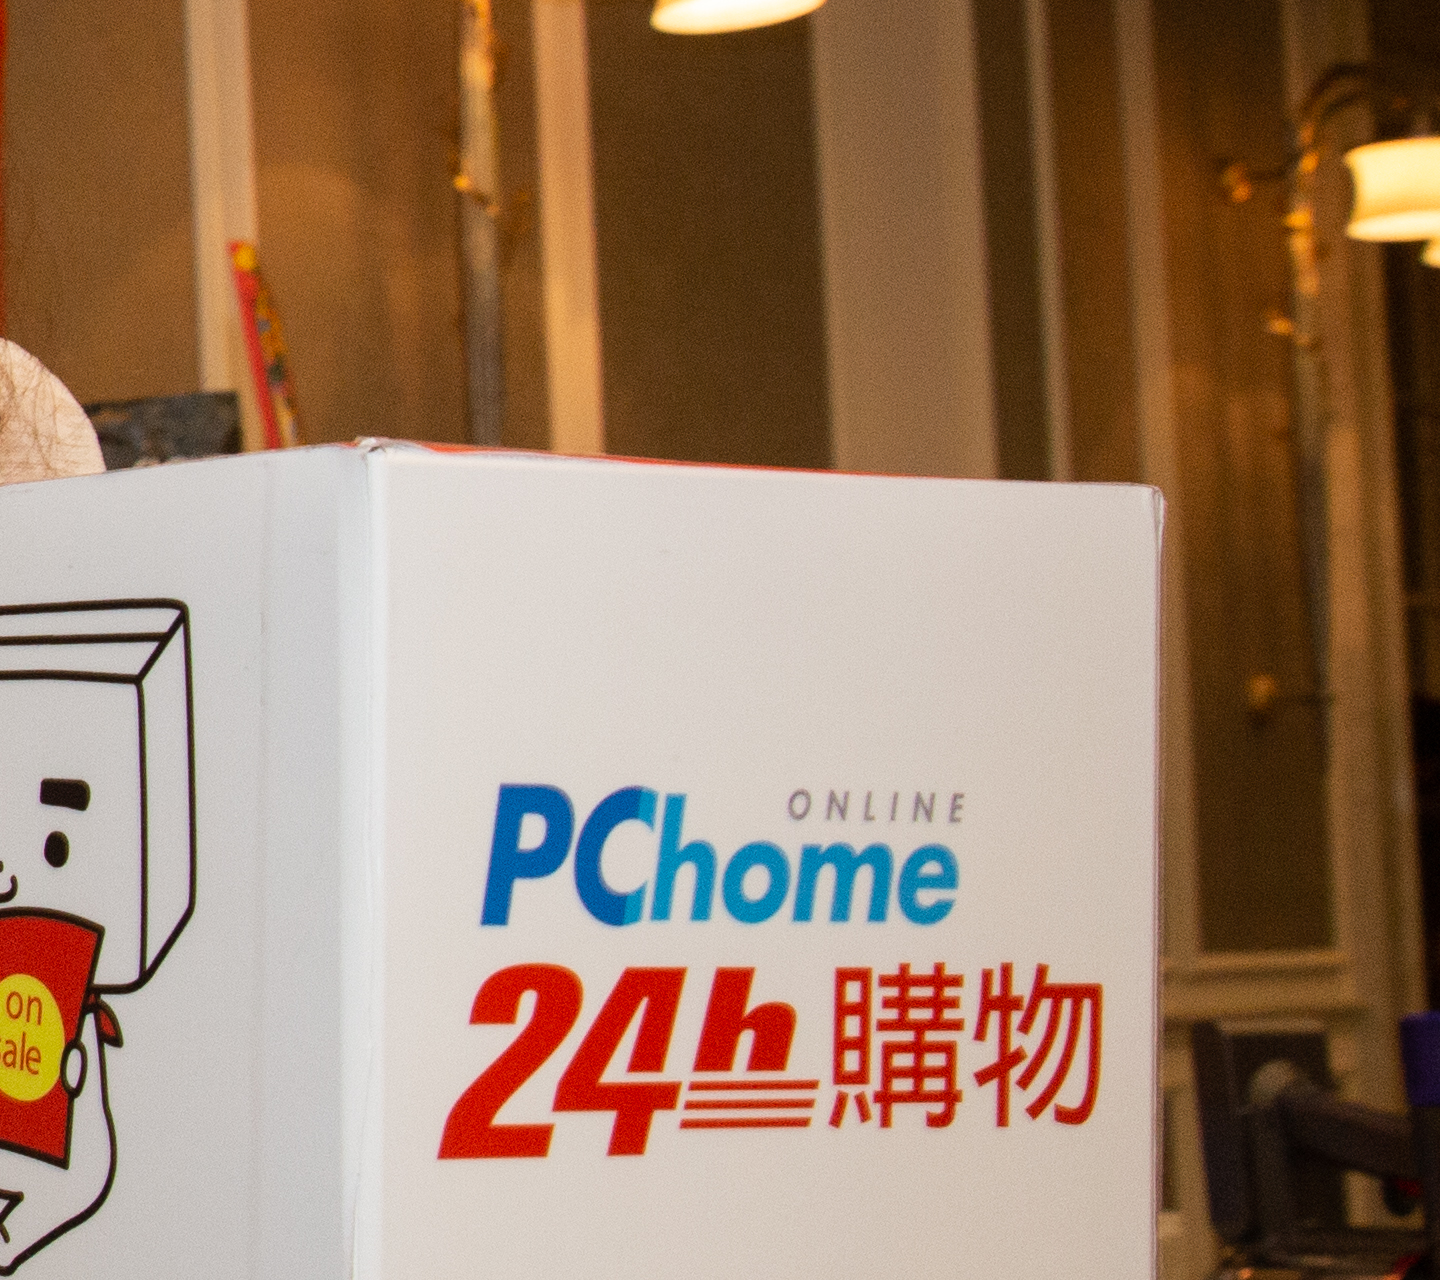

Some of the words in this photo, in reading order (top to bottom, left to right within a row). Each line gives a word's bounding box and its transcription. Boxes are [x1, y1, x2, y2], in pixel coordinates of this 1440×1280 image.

[787, 788, 967, 824] ONLINE
[480, 782, 961, 927] PChome
[5, 991, 43, 1025] on
